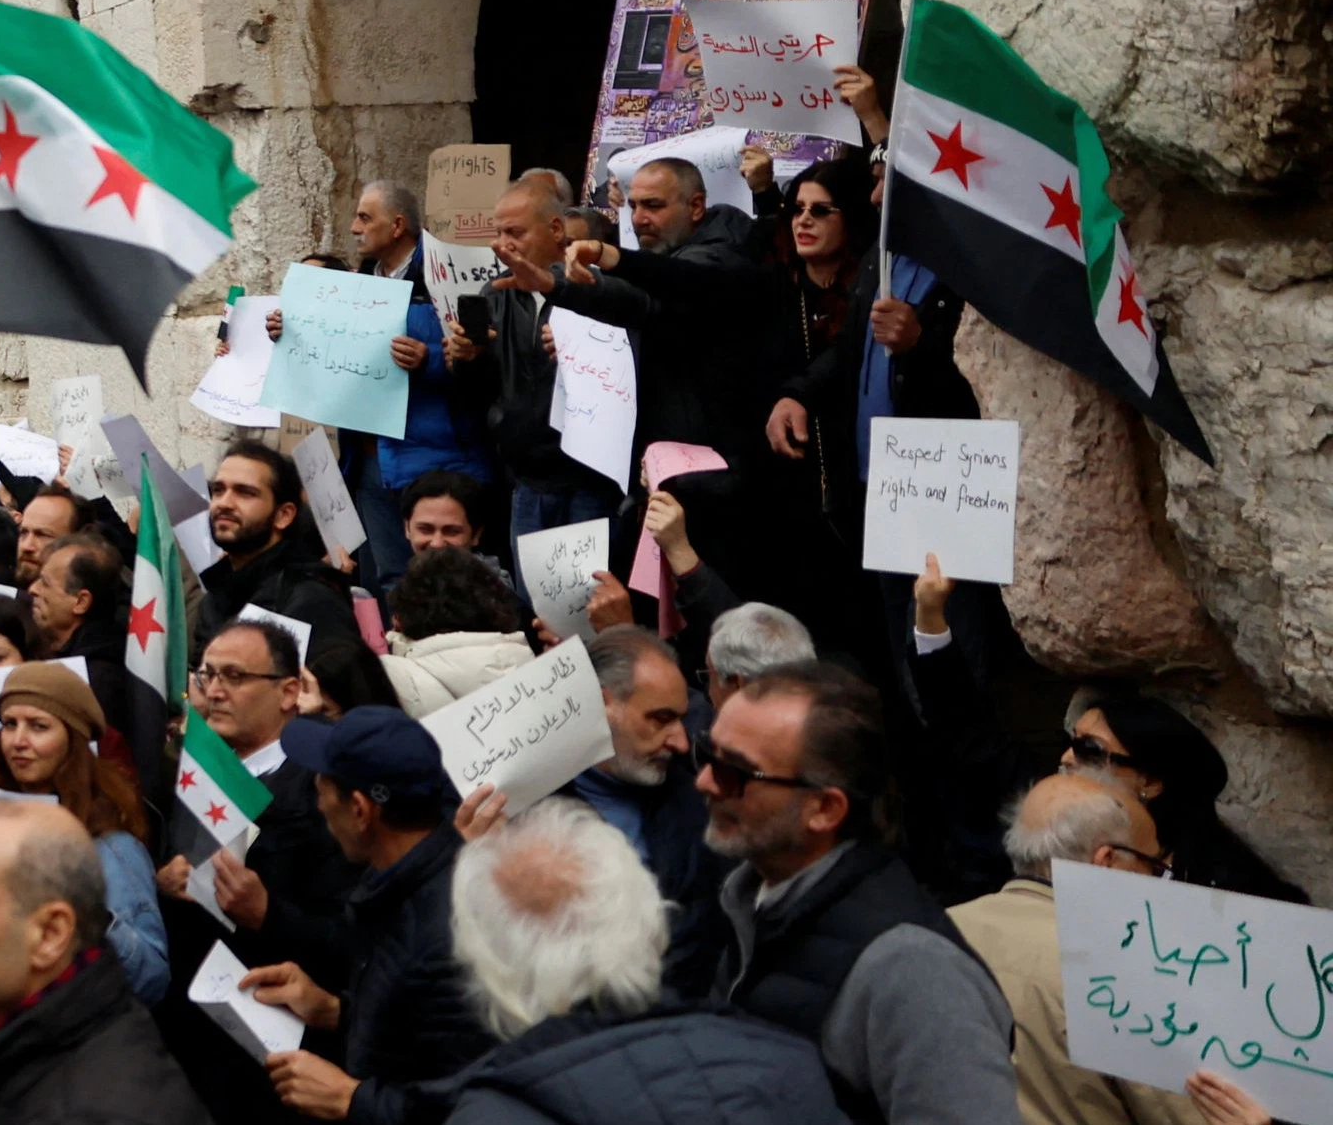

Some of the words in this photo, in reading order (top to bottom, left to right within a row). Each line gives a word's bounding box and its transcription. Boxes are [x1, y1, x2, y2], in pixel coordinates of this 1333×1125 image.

[702, 33, 760, 57] الشخصية
[763, 33, 835, 62] حريتي
[706, 84, 784, 113] دستوري
[453, 155, 497, 177] rights
[454, 213, 494, 229] Justic
[372, 365, 389, 381] لا
[886, 435, 946, 468] Respect
[958, 443, 1007, 478] Syrians
[880, 476, 918, 512] rights
[925, 486, 947, 503] and
[957, 483, 1009, 513] freedom
[540, 656, 576, 695] نطالب
[462, 736, 523, 787] الدستوري
[1121, 900, 1252, 988] أحياء
[1086, 975, 1199, 1047] مؤدبة
